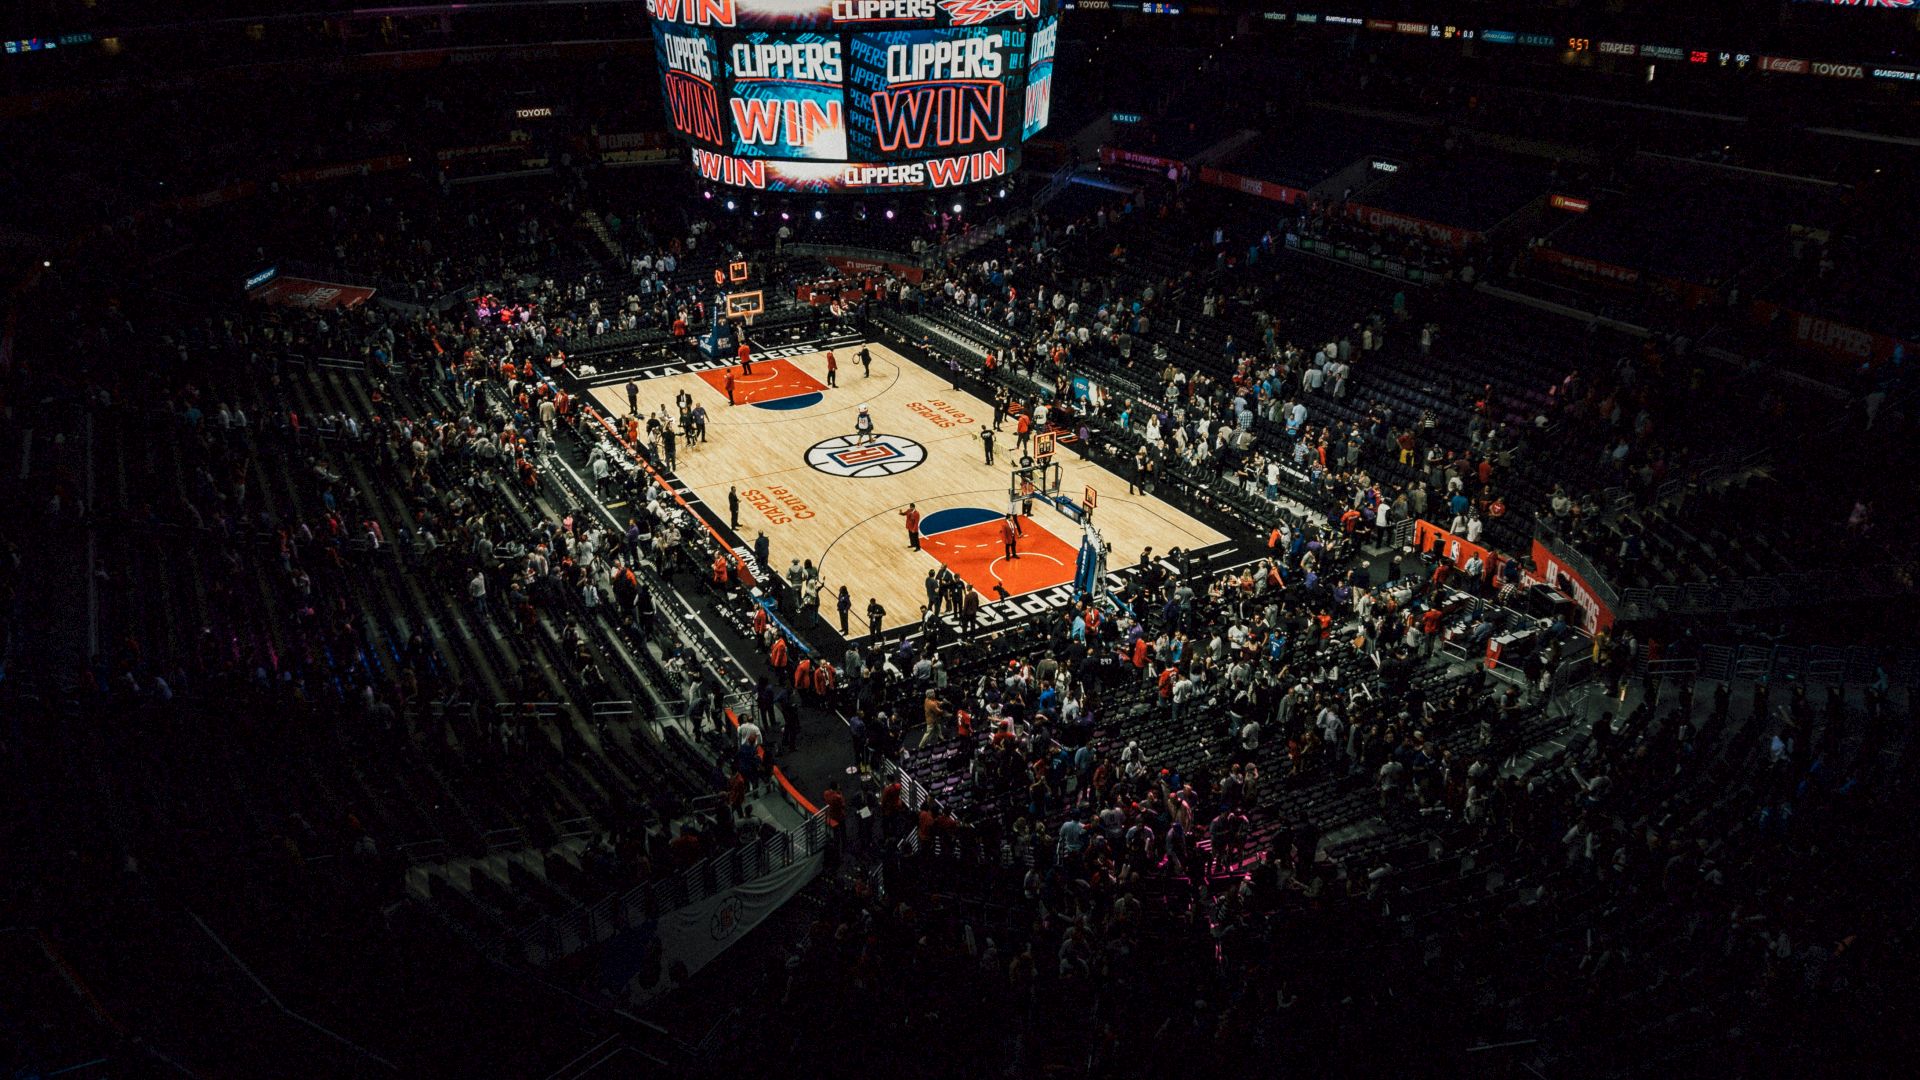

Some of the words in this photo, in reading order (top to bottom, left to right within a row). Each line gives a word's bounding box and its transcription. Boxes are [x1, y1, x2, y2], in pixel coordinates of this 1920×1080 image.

[653, 0, 736, 27] WIN
[832, 0, 936, 20] CLIPPERS
[1078, 1, 1110, 9] TOYOTA
[1264, 12, 1286, 21] verizon
[1397, 23, 1428, 33] TOSHIBA
[1527, 36, 1554, 46] DELTA
[1030, 20, 1058, 65] CLIPPERS
[1599, 41, 1635, 55] STAPLES
[664, 33, 711, 81] CLIPPERS
[732, 41, 843, 82] CLIPPERS
[887, 34, 1003, 83] CLIPPERS
[1812, 62, 1864, 79] TOYOTA
[516, 107, 552, 118] TOYOTA
[664, 73, 723, 146] WIN
[730, 97, 843, 147] WIN
[871, 83, 1004, 151] WIN
[699, 148, 766, 189] WIN
[844, 162, 925, 184] CLIPPERS
[926, 148, 1005, 188] WIN
[1372, 160, 1398, 173] verizon
[643, 366, 682, 379] LA
[906, 402, 956, 430] STAPLES
[927, 399, 976, 424] Center
[741, 489, 792, 525] STAPLES
[767, 485, 816, 520] Center
